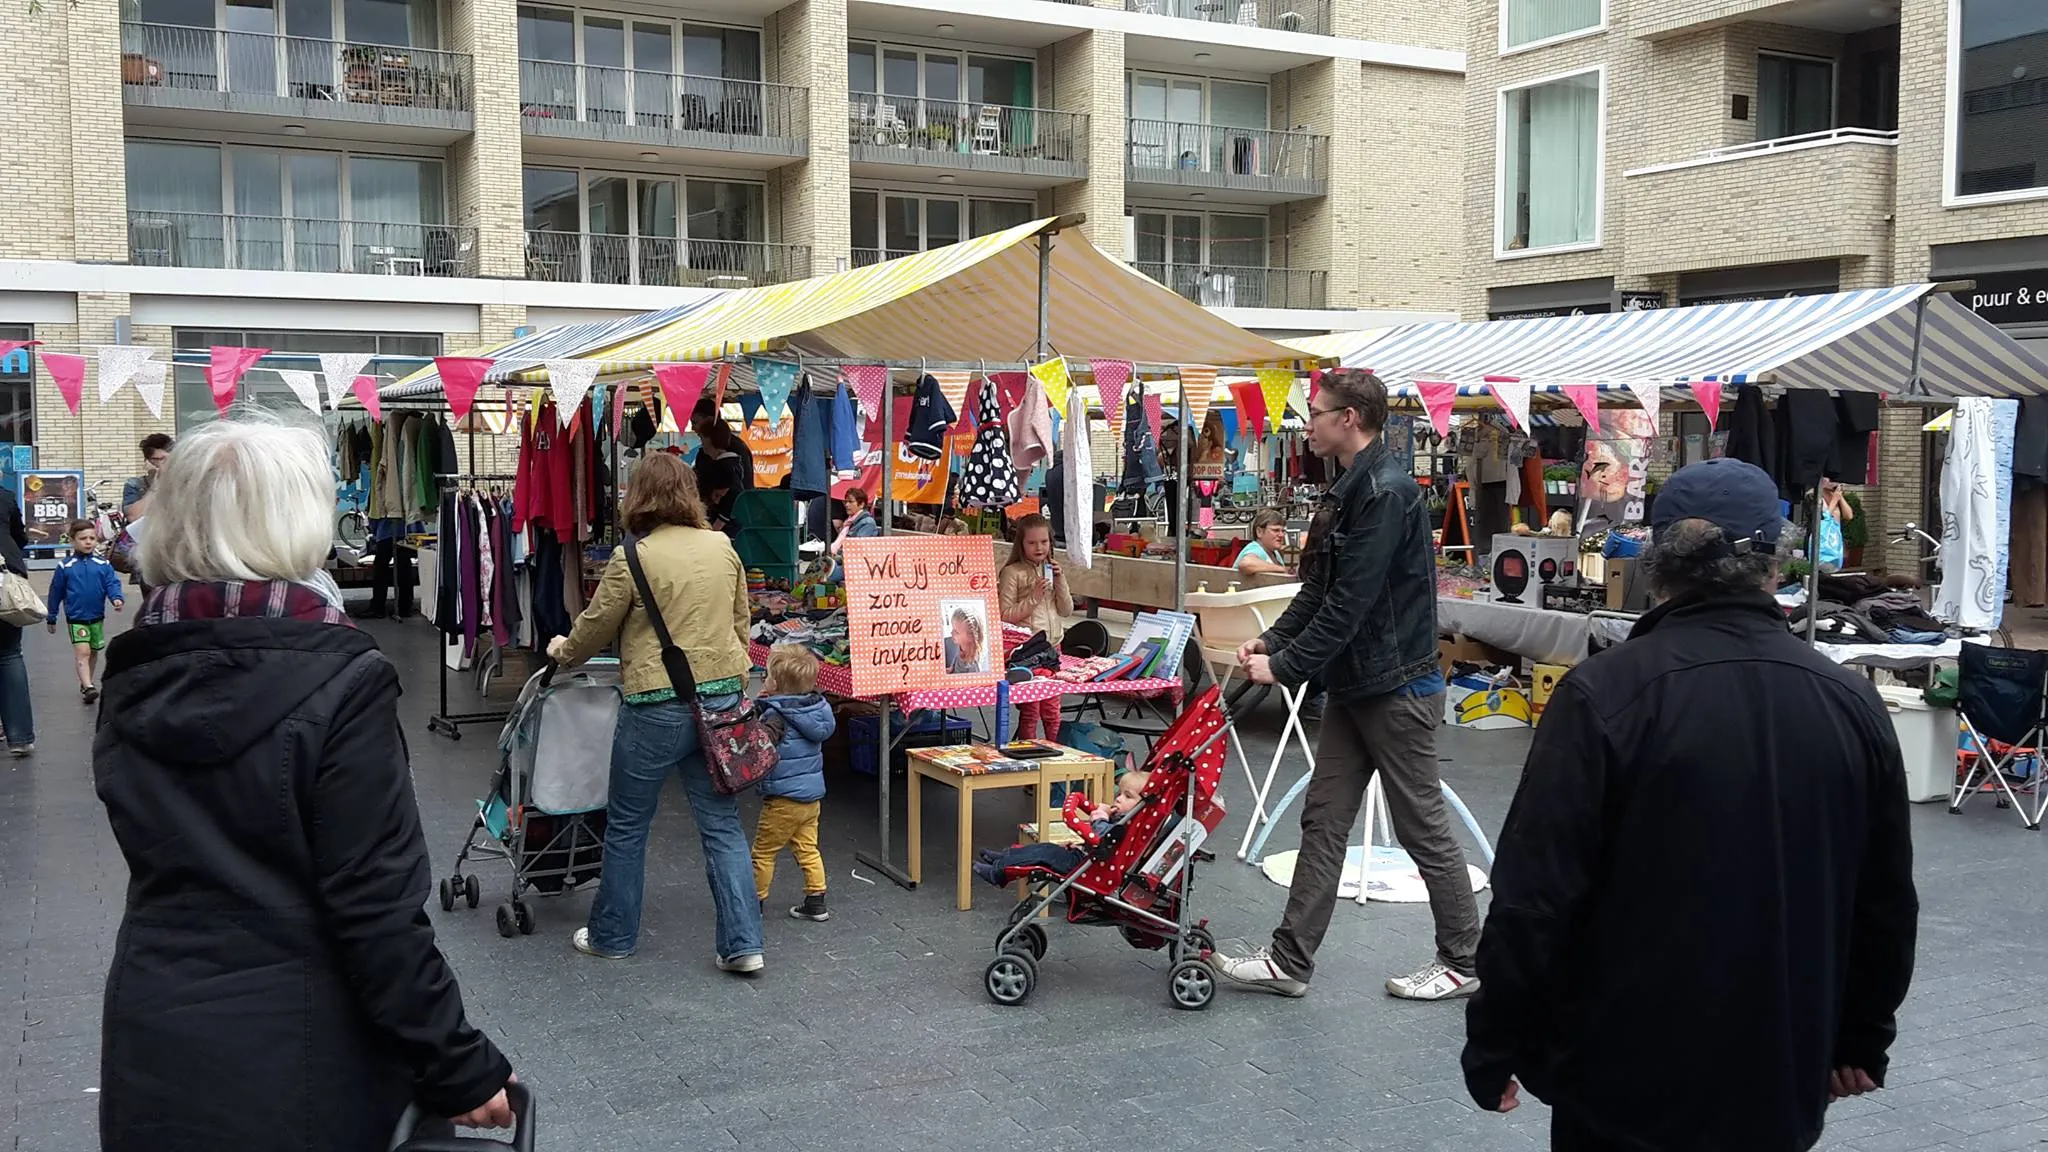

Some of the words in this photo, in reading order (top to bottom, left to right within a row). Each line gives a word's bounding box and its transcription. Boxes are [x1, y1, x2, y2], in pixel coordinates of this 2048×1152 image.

[1973, 292, 2012, 312] puur
[2017, 287, 2031, 305] &
[2036, 290, 2048, 304] e
[33, 503, 69, 518] BBQ
[863, 552, 900, 580] Wil
[904, 558, 928, 590] jij
[938, 555, 968, 576] ook
[969, 575, 992, 590] €2
[871, 616, 923, 637] mooie
[872, 638, 941, 666] invlecht
[901, 664, 909, 685] ?
